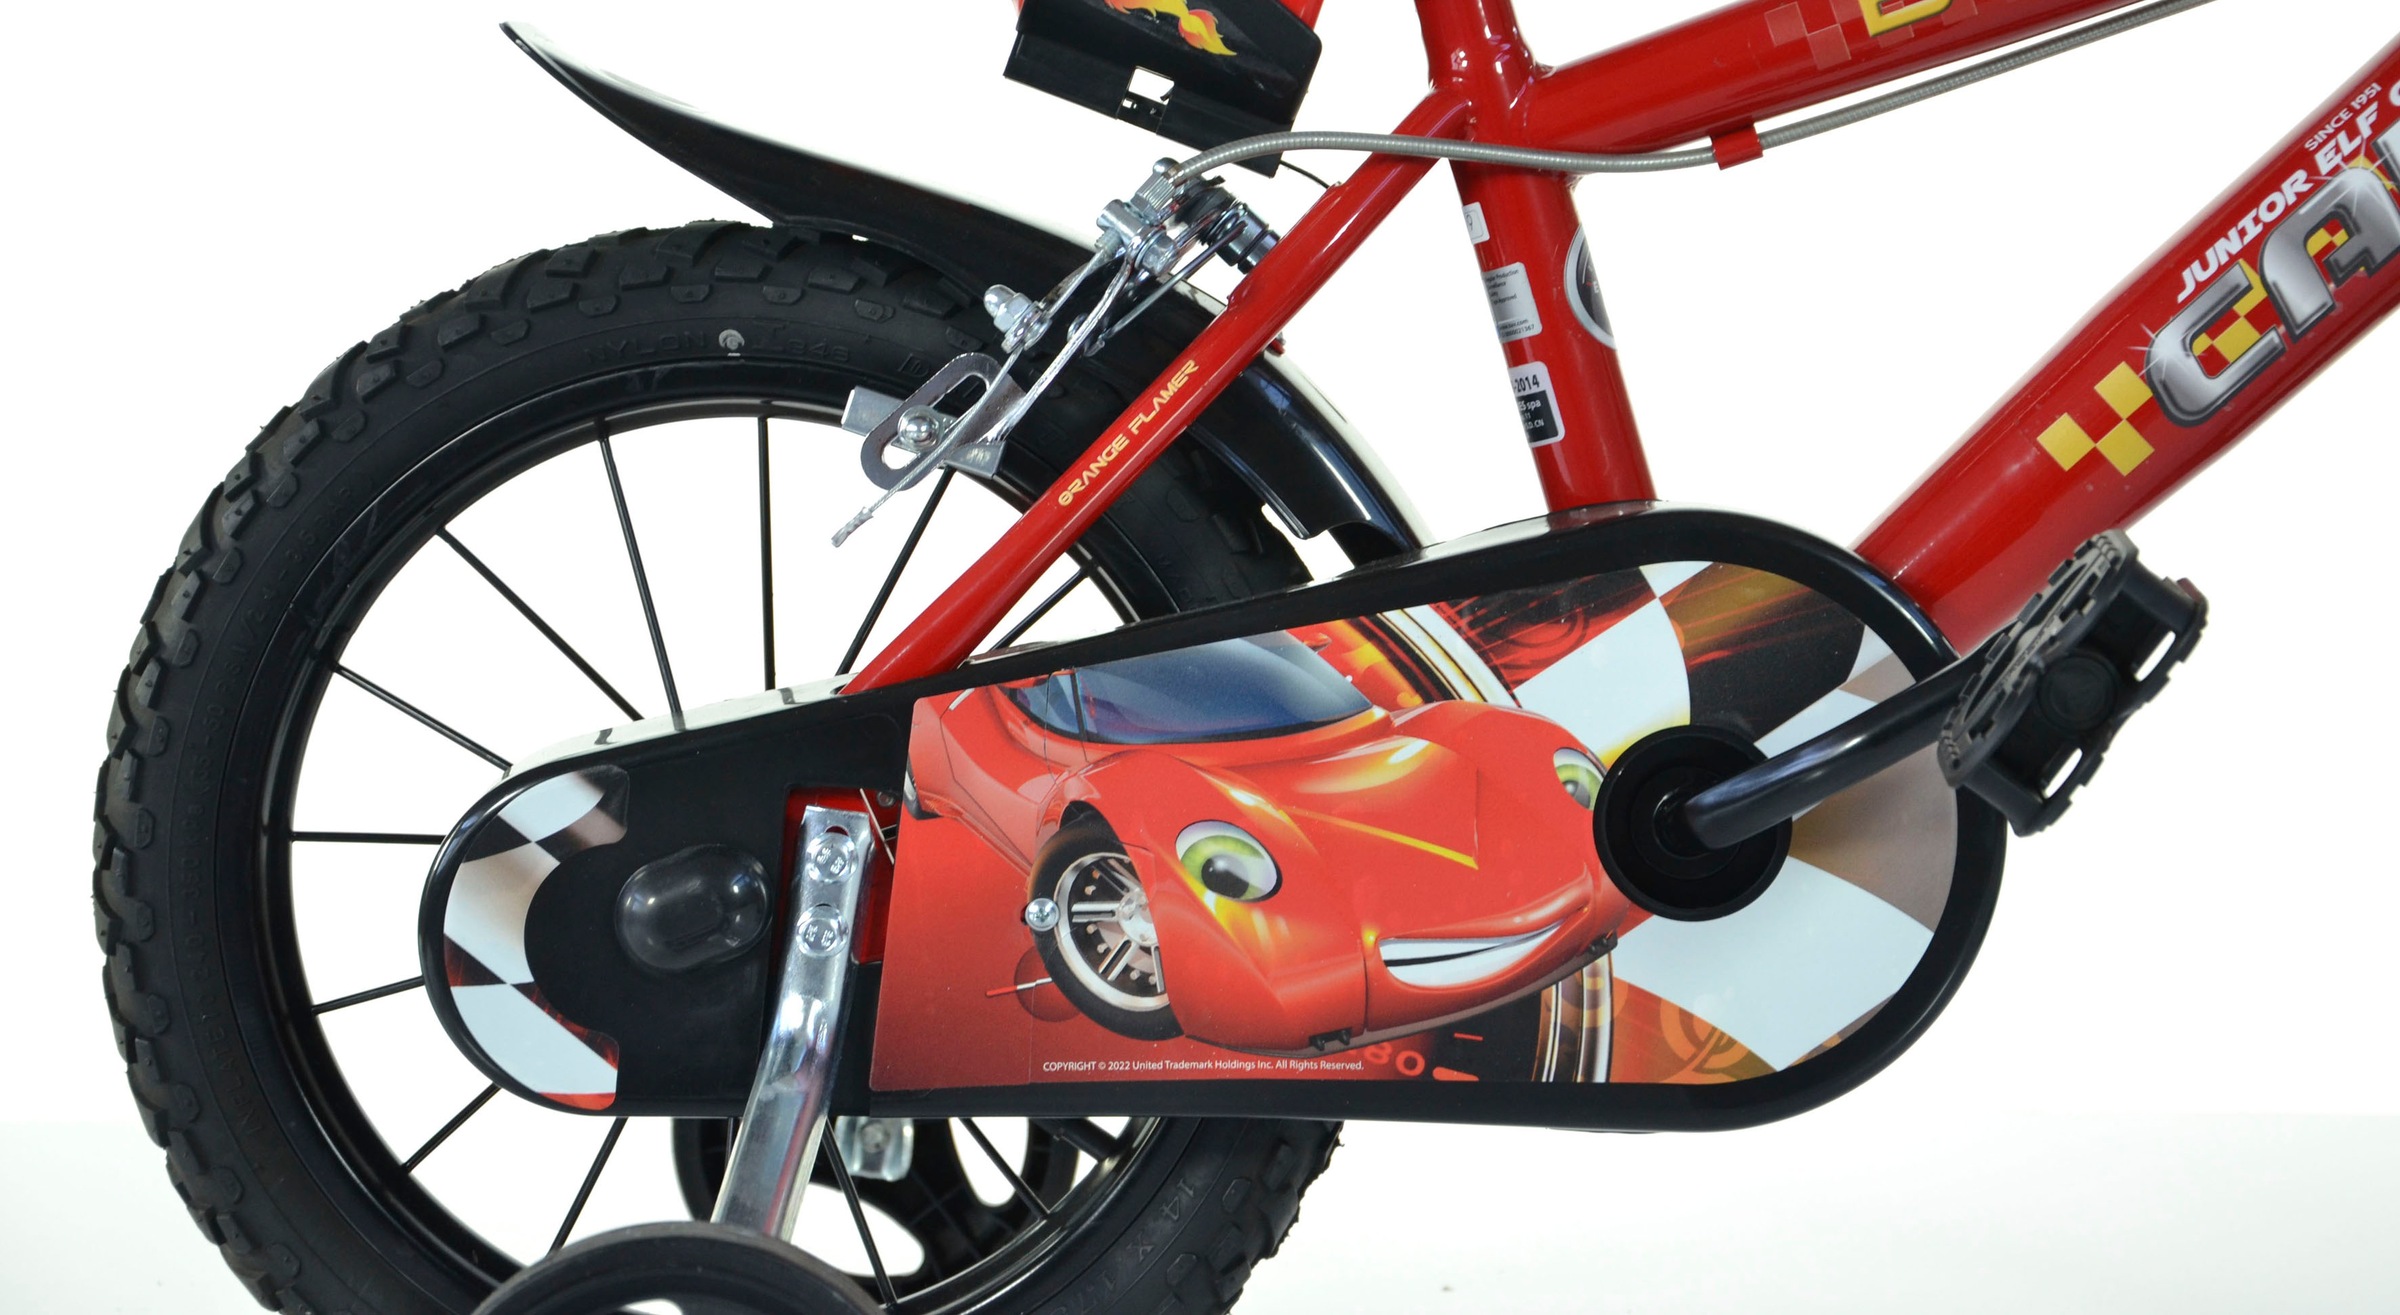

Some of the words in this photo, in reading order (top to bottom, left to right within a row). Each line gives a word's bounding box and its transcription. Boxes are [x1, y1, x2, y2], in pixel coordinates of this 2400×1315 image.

[2305, 108, 2353, 151] SINCE
[2350, 82, 2382, 111] 1951
[2177, 168, 2313, 303] JUNIOR
[2314, 101, 2378, 176] ELF
[2144, 117, 2400, 428] CA
[1128, 359, 1199, 435] FLAMER
[1043, 1061, 1096, 1072] COPYRIGHT
[1108, 1061, 1130, 1071] 2022
[1132, 1060, 1163, 1071] United
[1165, 1059, 1213, 1070] Trademark
[1215, 1059, 1255, 1071] Holdings
[1257, 1060, 1274, 1070] Inc.
[1276, 1060, 1287, 1069] All
[1289, 1060, 1318, 1071] Rights
[1320, 1060, 1364, 1071] Reserved.
